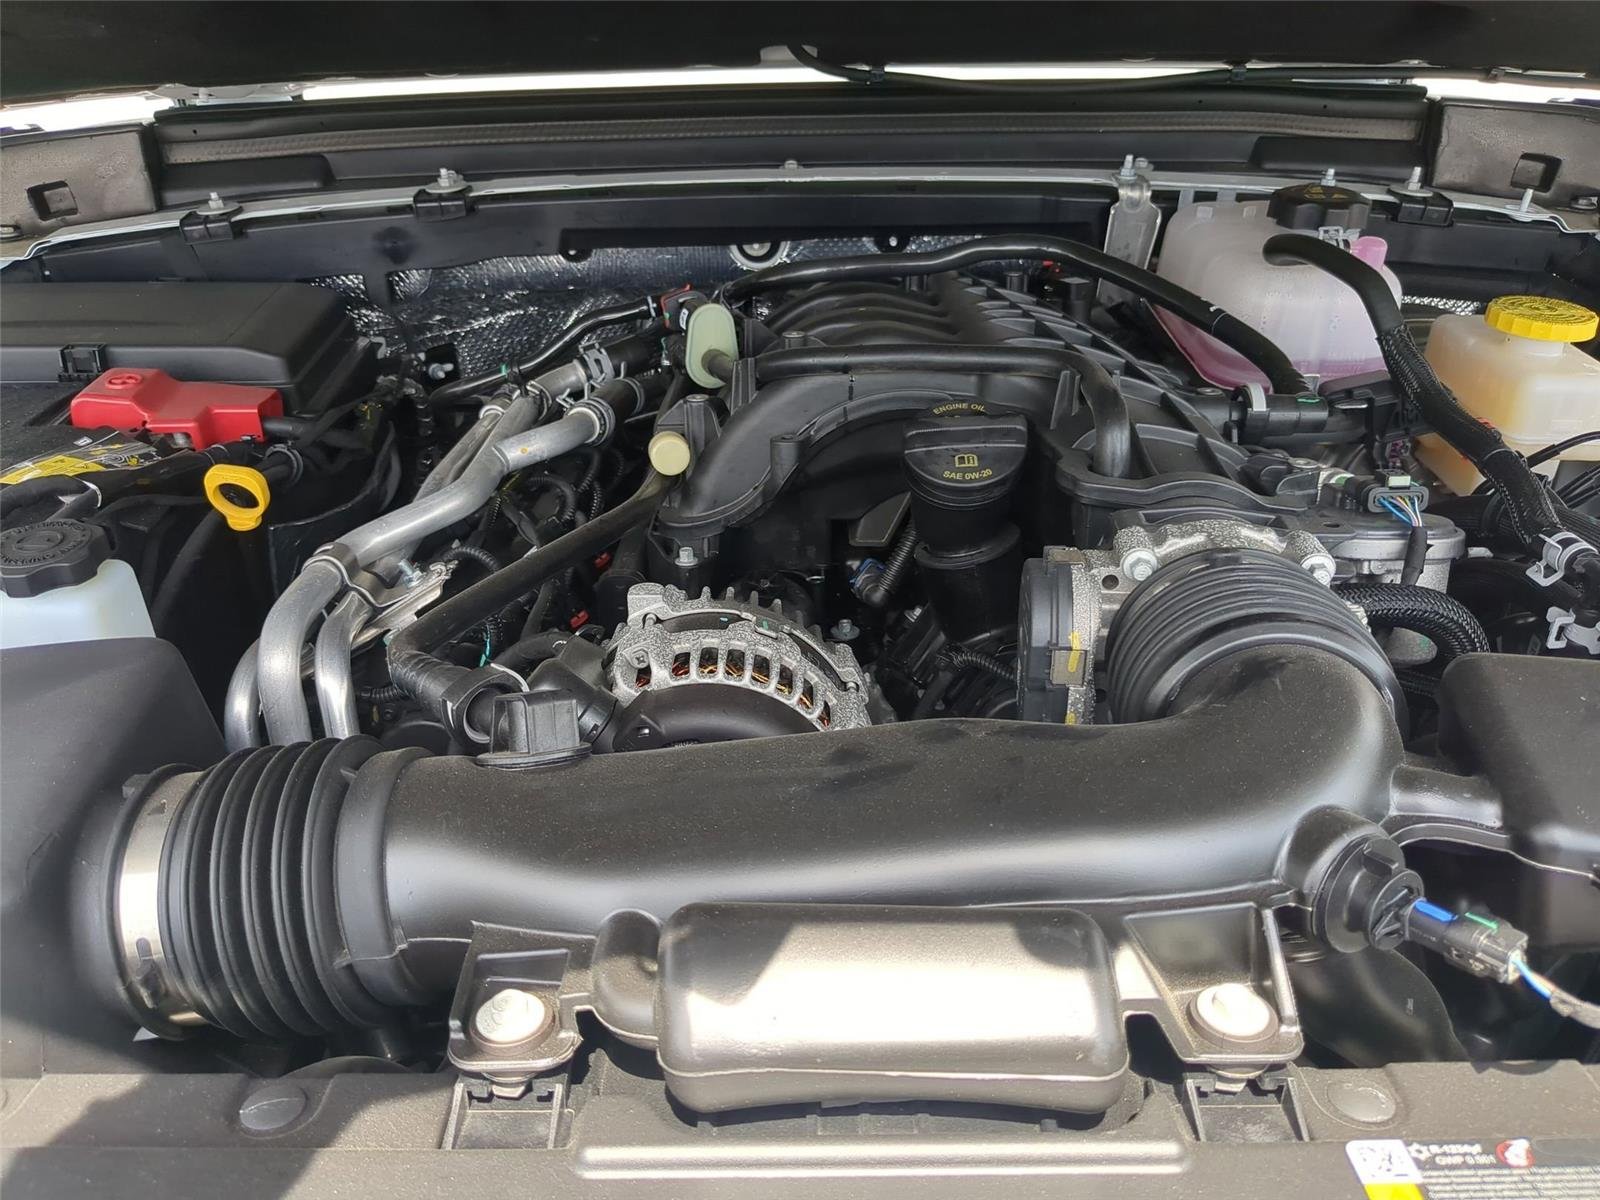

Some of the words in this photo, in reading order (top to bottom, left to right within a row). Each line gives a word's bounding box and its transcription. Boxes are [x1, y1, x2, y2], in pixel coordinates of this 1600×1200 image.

[933, 402, 968, 415] ENGINE
[971, 402, 986, 413] OIL
[943, 470, 962, 480] SAE
[965, 468, 993, 480] 0W-20
